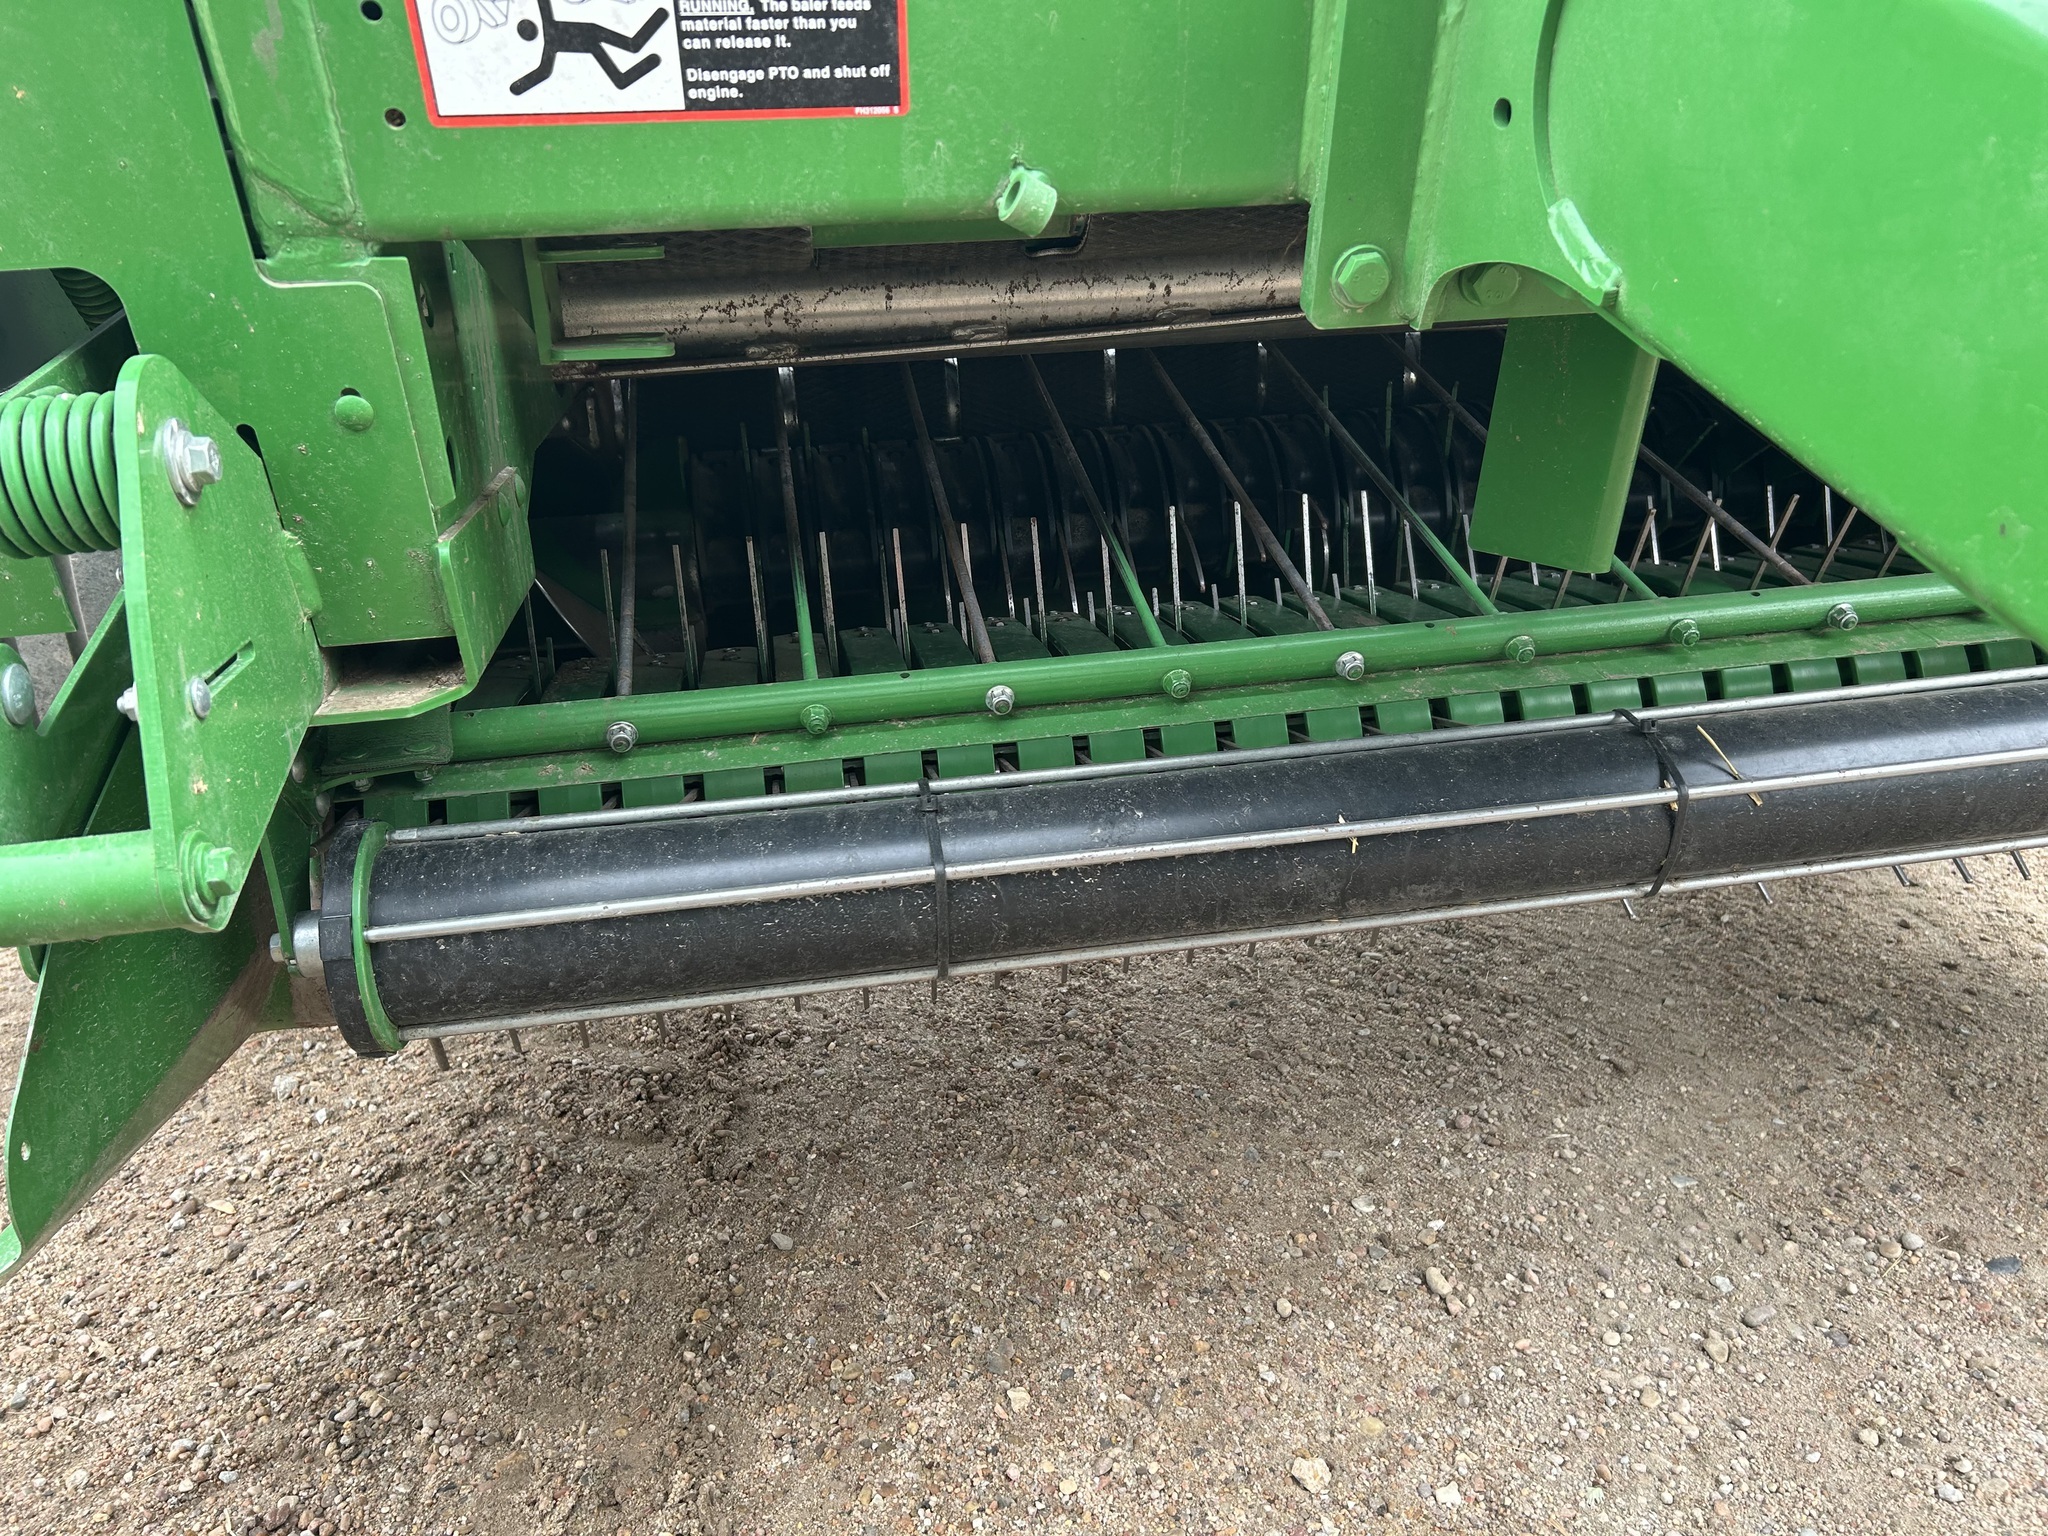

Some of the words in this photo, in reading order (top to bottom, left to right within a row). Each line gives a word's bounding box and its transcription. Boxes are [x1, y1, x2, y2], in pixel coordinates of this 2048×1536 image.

[680, 0, 755, 16] RUNNING.
[759, 0, 788, 12] The
[791, 0, 828, 12] baler
[831, 0, 872, 12] feeds
[680, 17, 742, 31] material
[746, 16, 790, 31] faster
[793, 16, 826, 30] than
[829, 17, 857, 32] you
[682, 37, 711, 49] can
[715, 35, 772, 49] release
[774, 34, 792, 48] it.
[686, 67, 765, 84] Disengage
[768, 65, 800, 80] PTO
[802, 66, 831, 79] and
[833, 65, 867, 78] shut
[869, 64, 891, 78] off
[688, 85, 744, 102] engine.
